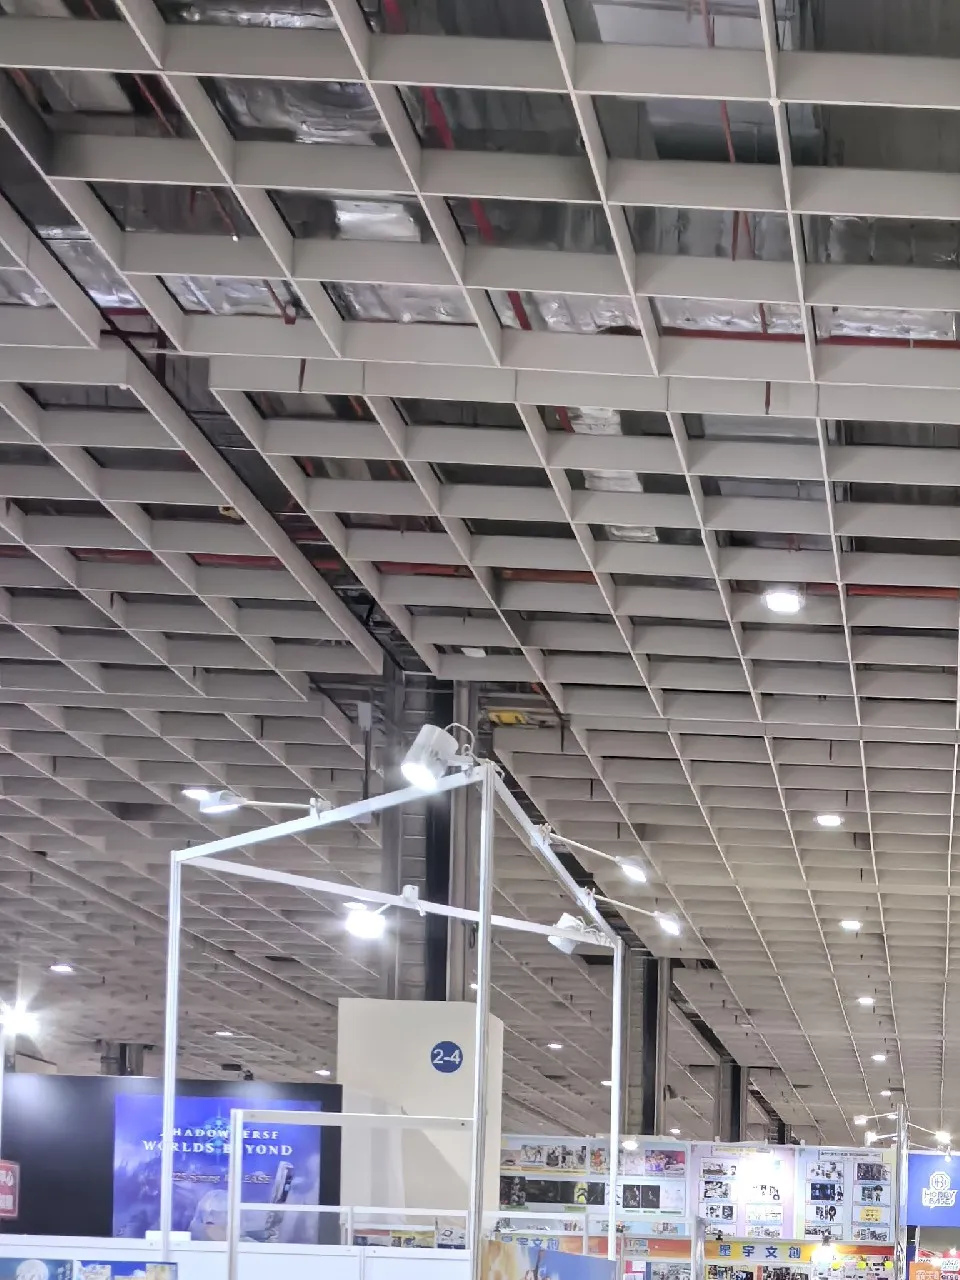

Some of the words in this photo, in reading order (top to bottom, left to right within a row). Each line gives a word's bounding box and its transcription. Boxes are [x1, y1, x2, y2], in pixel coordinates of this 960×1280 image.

[433, 1049, 461, 1064] 2-4
[160, 1127, 280, 1140] HADOWERSE
[222, 1143, 293, 1156] BYOND
[719, 1244, 801, 1259] 星宇文創
